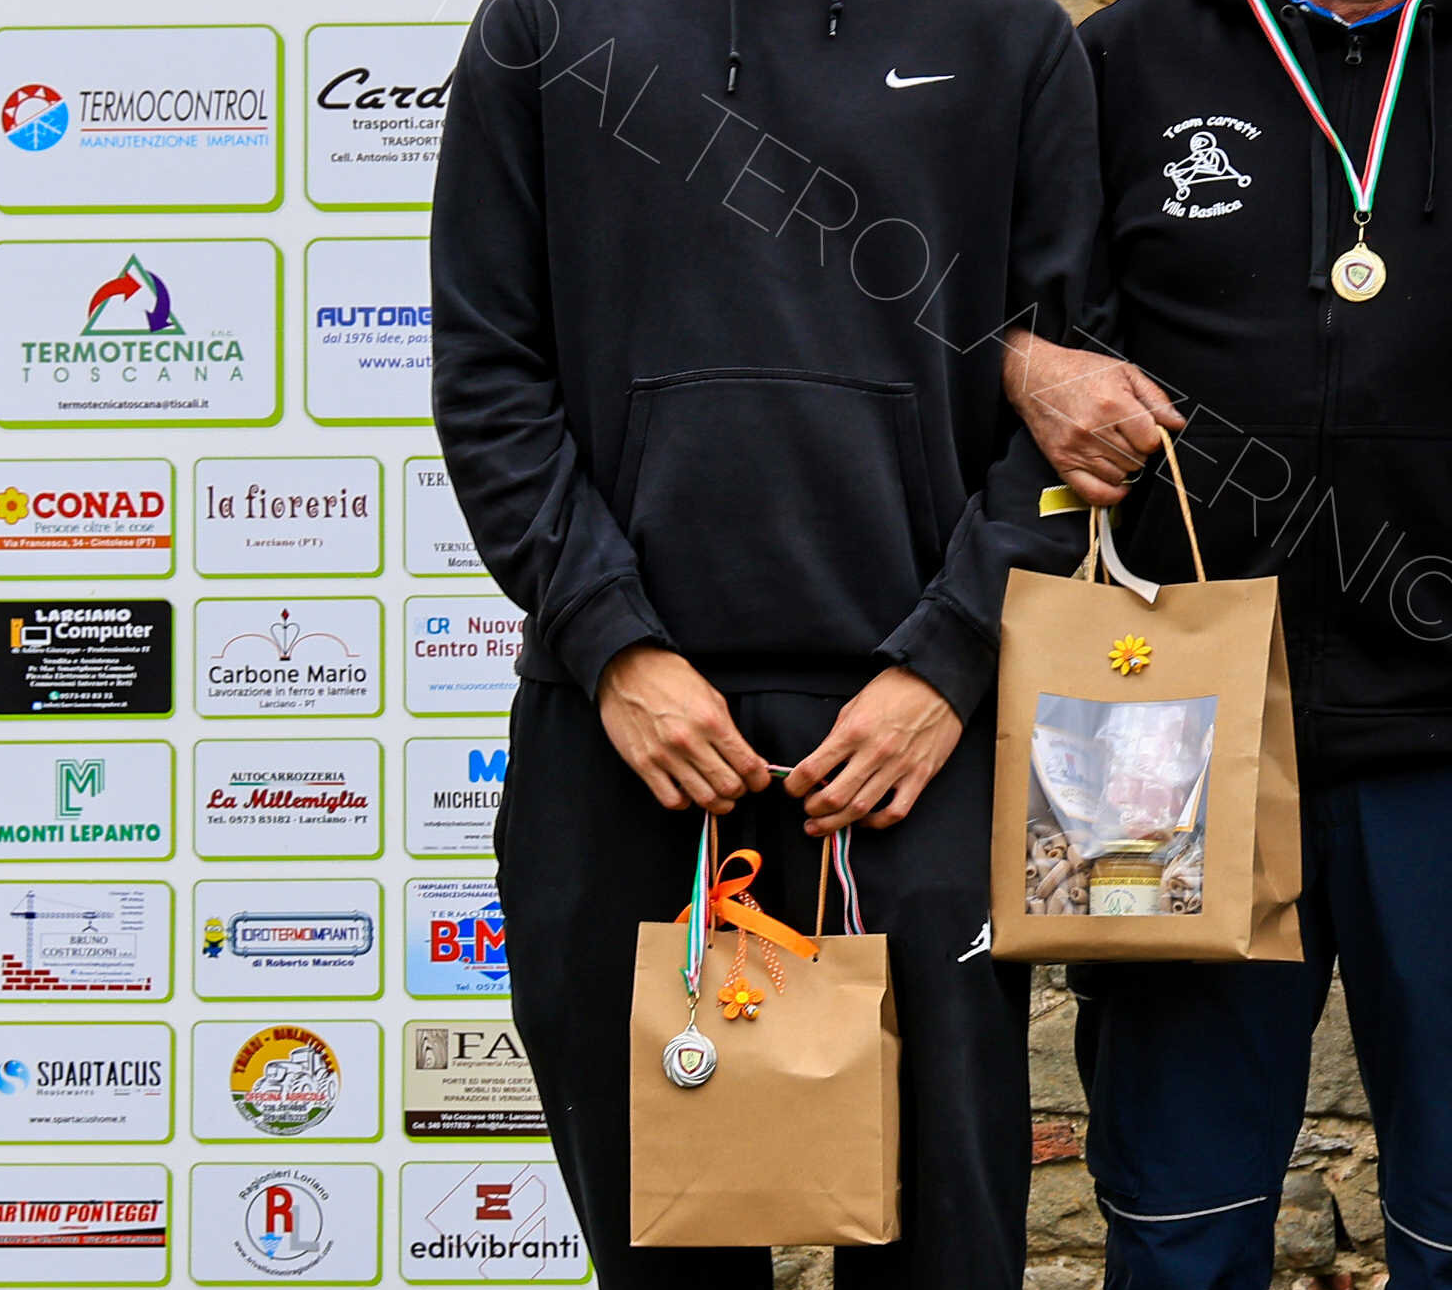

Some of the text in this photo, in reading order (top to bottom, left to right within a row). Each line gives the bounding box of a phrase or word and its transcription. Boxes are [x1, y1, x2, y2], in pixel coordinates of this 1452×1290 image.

[79, 90, 268, 122] TERMOCONTROL
[1163, 115, 1263, 141] Team carretti
[79, 134, 268, 149] MANUTENZIONE IMPIANTI
[1161, 197, 1243, 219] Villa Basilica
[22, 340, 244, 363] TERMOTECNICA
[22, 366, 244, 382] TOSCANA
[32, 491, 165, 519] CONAD
[207, 485, 368, 520] la fioreria
[35, 522, 79, 534] Persone
[35, 609, 132, 623] LARCIANO
[55, 623, 153, 643] Computer
[415, 640, 478, 657] Centro
[209, 665, 366, 684] Carbone Mario
[209, 685, 366, 698] Lavorazione ferro lamiere
[230, 771, 344, 782] AUTOCARROZZERIA
[207, 788, 368, 813] La Millemiglia
[70, 824, 160, 842] LEPANTO
[42, 948, 116, 957] COSTRUZIONI
[452, 1032, 525, 1059] FA
[37, 1061, 161, 1086] SPARTACUS
[239, 1170, 329, 1200] Ragionieri Loriano
[65, 1202, 158, 1222] PONTEGGI
[410, 1234, 580, 1260] edilvibranti
